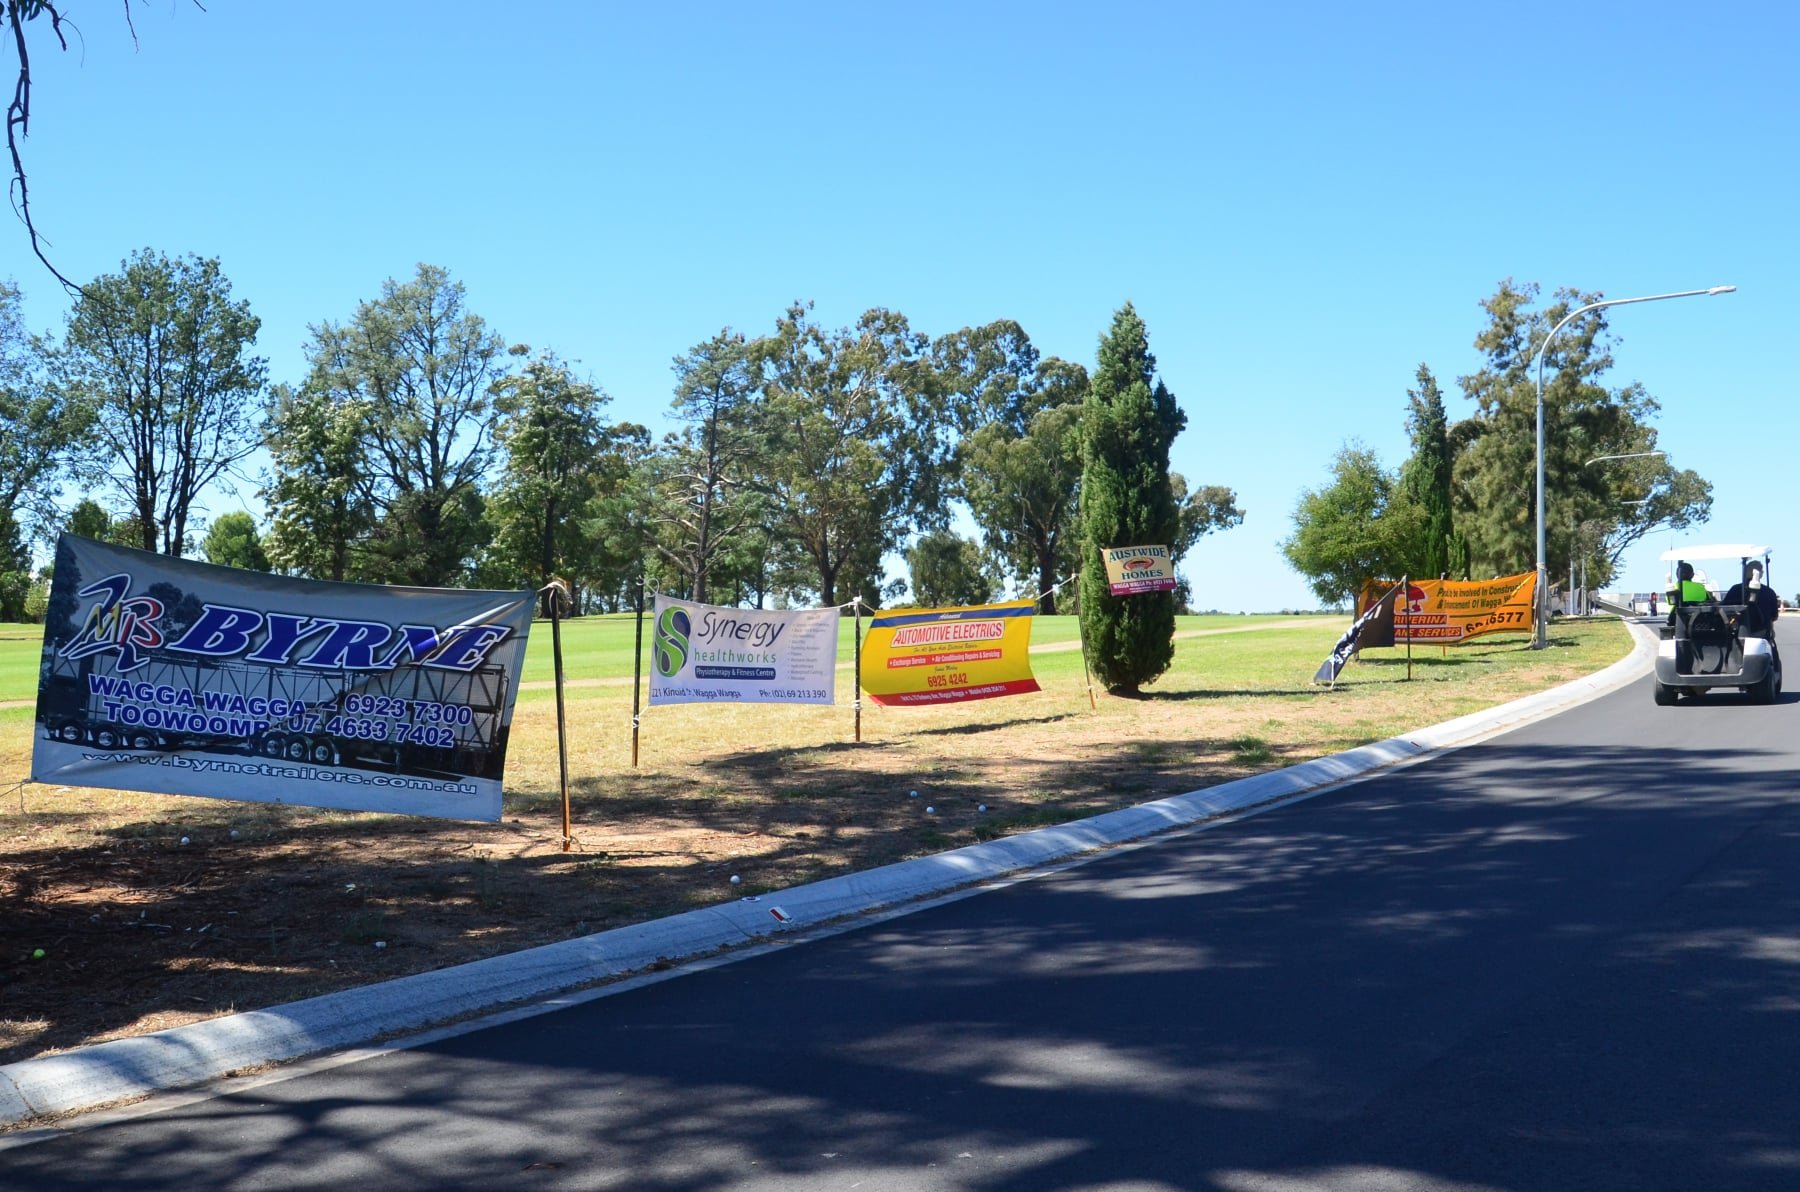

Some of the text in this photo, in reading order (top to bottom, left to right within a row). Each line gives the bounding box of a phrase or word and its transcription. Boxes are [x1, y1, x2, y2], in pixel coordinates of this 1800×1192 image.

[1109, 547, 1167, 562] AUSTWIDE
[1122, 570, 1164, 580] HOMES
[1490, 611, 1524, 624] 6577
[698, 612, 785, 647] Synergy
[894, 622, 1002, 644] AUTOMOTIVE ELECTRICS
[166, 604, 512, 671] BYRNE
[694, 648, 777, 663] healthworks
[696, 668, 731, 677] Physiotherapy
[756, 669, 774, 677] Centre
[928, 673, 968, 687] 6925 4242
[88, 674, 195, 708] WAGGA
[203, 691, 305, 717] WAGGA
[345, 693, 407, 719] 6923
[414, 701, 472, 726] 7300
[694, 689, 717, 699] Wagga
[717, 689, 741, 699] Wagga
[787, 690, 795, 698] 69
[797, 690, 811, 698] 213
[812, 690, 826, 698] 390
[103, 701, 454, 747] TOOWOOMB 07 4633 7402
[82, 753, 477, 794] www.byrnetrailers.com.au
